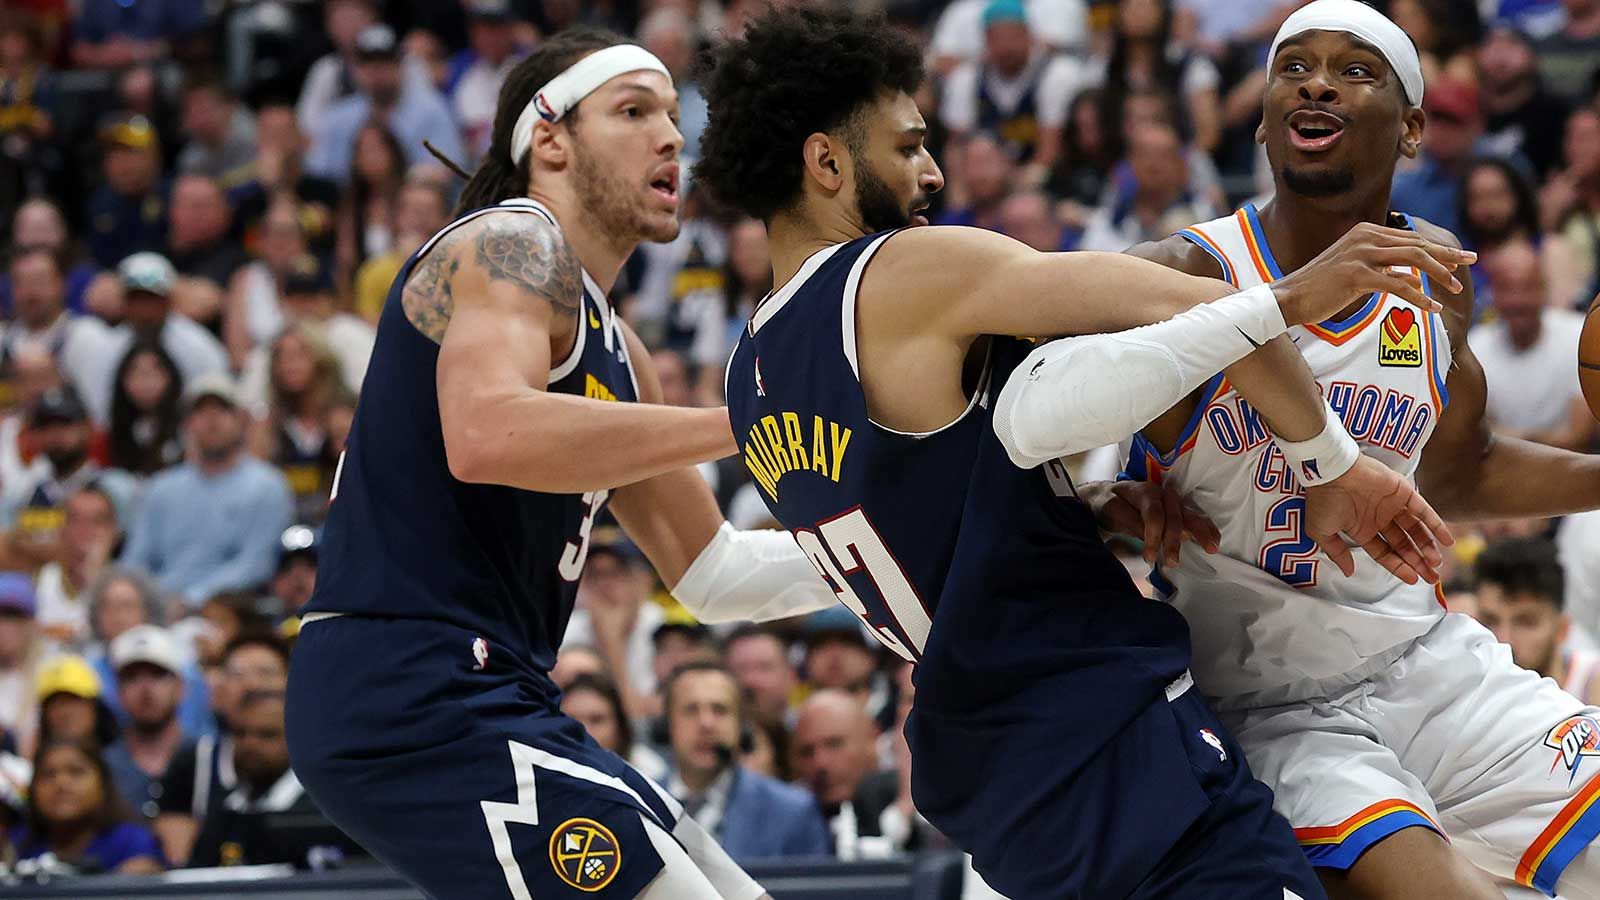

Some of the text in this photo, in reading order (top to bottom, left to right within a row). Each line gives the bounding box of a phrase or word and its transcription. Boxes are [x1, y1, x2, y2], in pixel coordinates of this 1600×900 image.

[1381, 344, 1419, 362] Love's
[744, 411, 853, 504] MURRAY
[1205, 381, 1431, 459] OKHOMA
[793, 503, 934, 664] 27
[1258, 495, 1320, 589] 2
[1561, 719, 1593, 770] OKC
